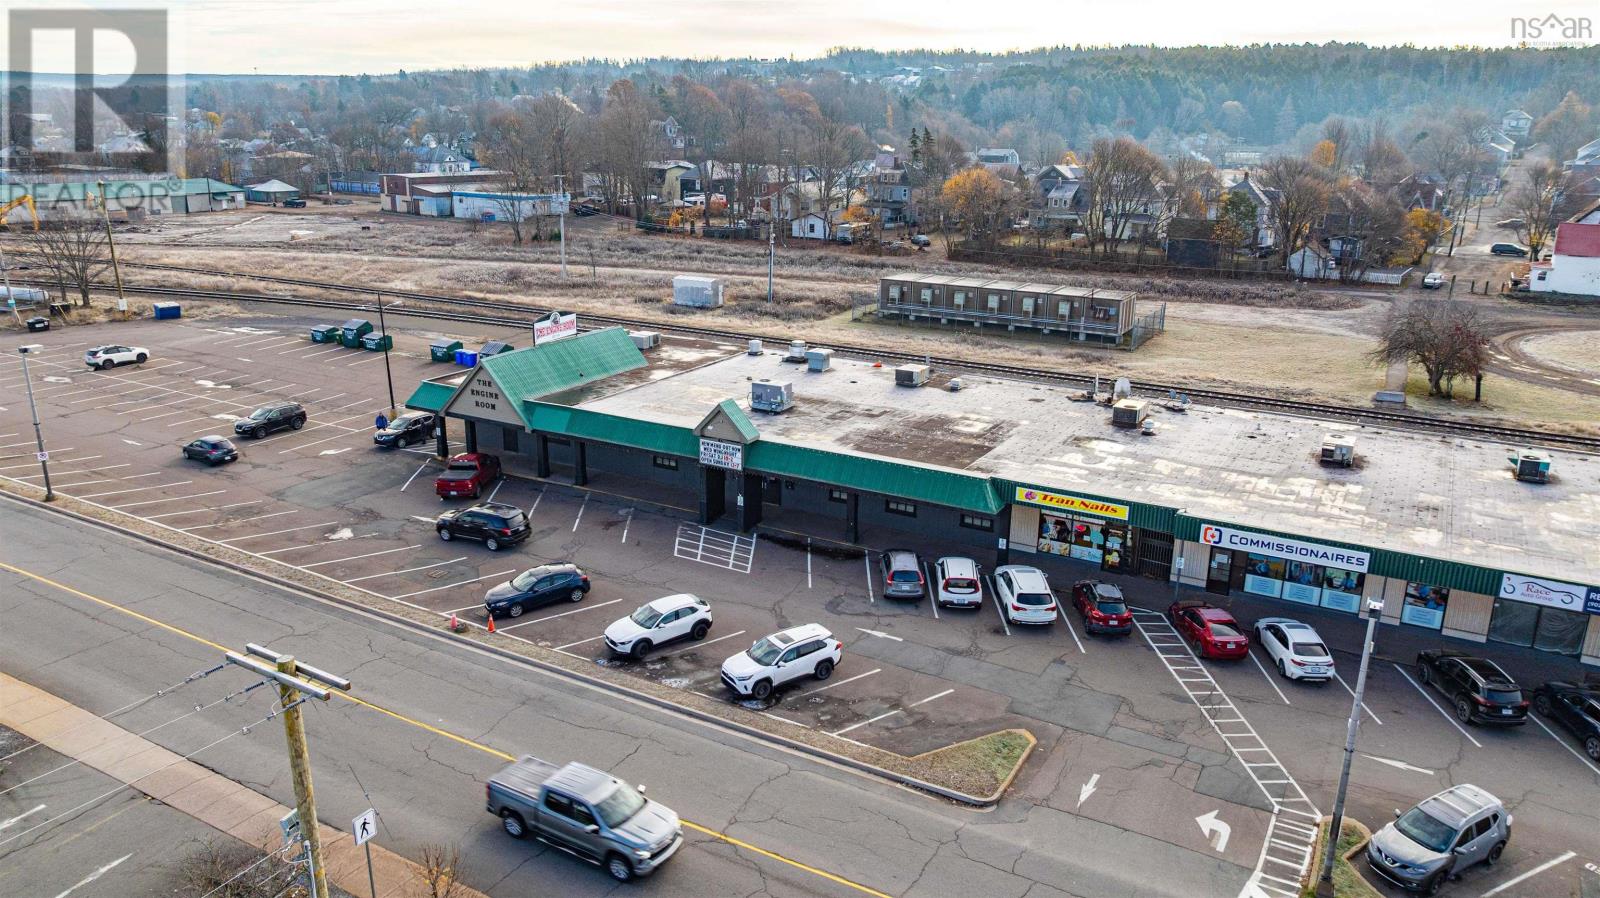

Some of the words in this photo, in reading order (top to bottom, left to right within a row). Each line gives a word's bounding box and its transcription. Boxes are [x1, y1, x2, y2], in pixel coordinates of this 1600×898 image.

[477, 379, 492, 387] THE
[471, 389, 499, 400] ENGINE
[475, 401, 496, 410] ROOM
[1041, 493, 1075, 506] Tran
[1079, 500, 1118, 514] Nails
[1526, 584, 1551, 596] Race
